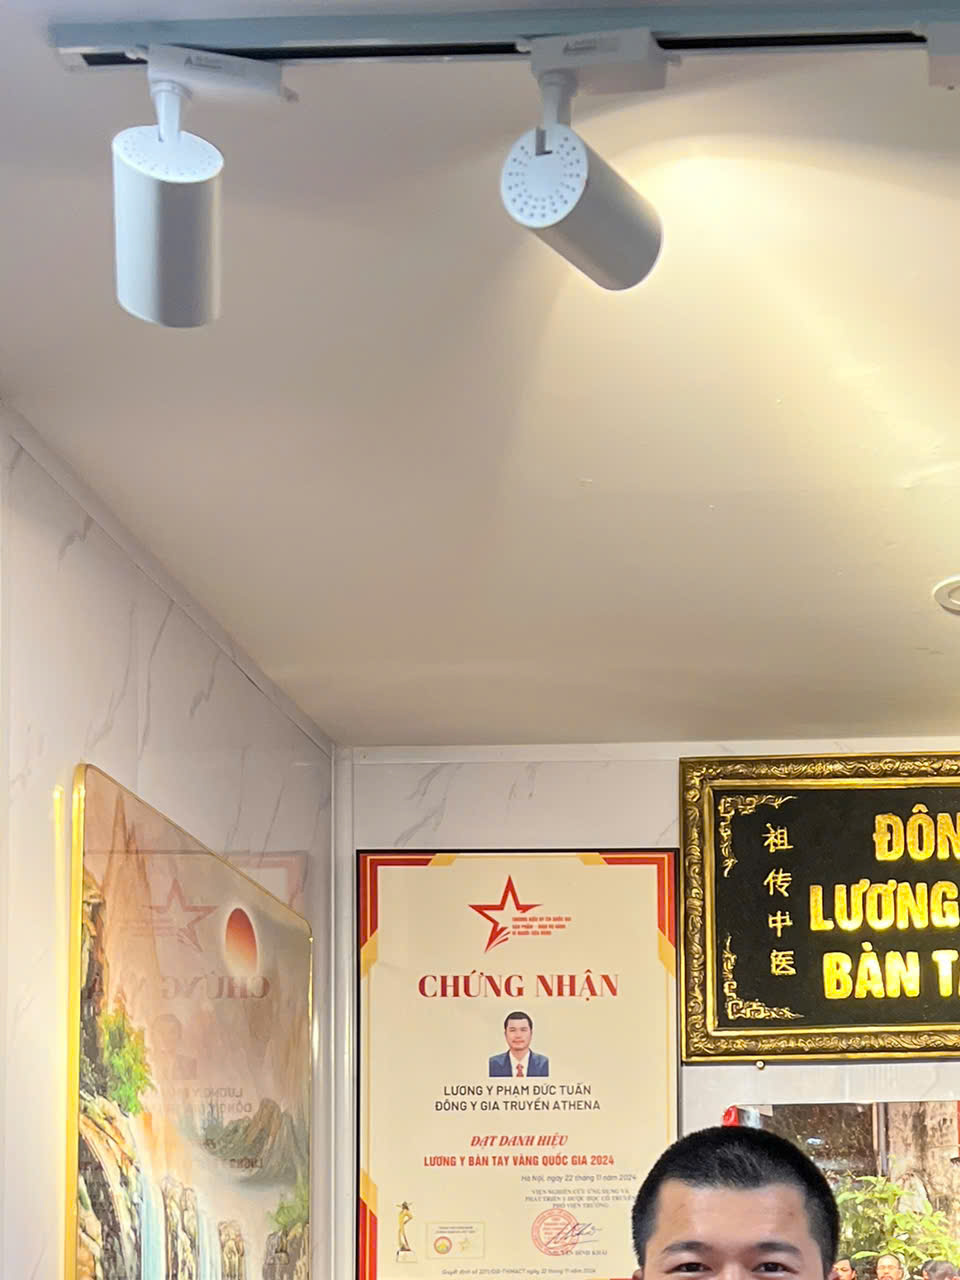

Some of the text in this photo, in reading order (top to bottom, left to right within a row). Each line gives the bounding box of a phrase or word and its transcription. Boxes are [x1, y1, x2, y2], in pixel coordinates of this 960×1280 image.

[761, 822, 797, 976] 祖传中医
[809, 879, 960, 931] LƯƠNG
[823, 941, 920, 999] BÀN
[418, 969, 619, 1001] CHỨNG NHẬN
[444, 1082, 591, 1098] LƯƠNG Y PHẠM ĐỨC TUẤN
[435, 1098, 467, 1111] ĐÔNG
[470, 1101, 477, 1111] Y
[480, 1100, 500, 1111] GIA
[552, 1100, 600, 1110] ATHENA
[471, 1132, 568, 1149] ĐẠT DANH HIỆU
[424, 1152, 614, 1167] LƯƠNG Y BÀN TAY VÀNG QUỐC GIA 2024
